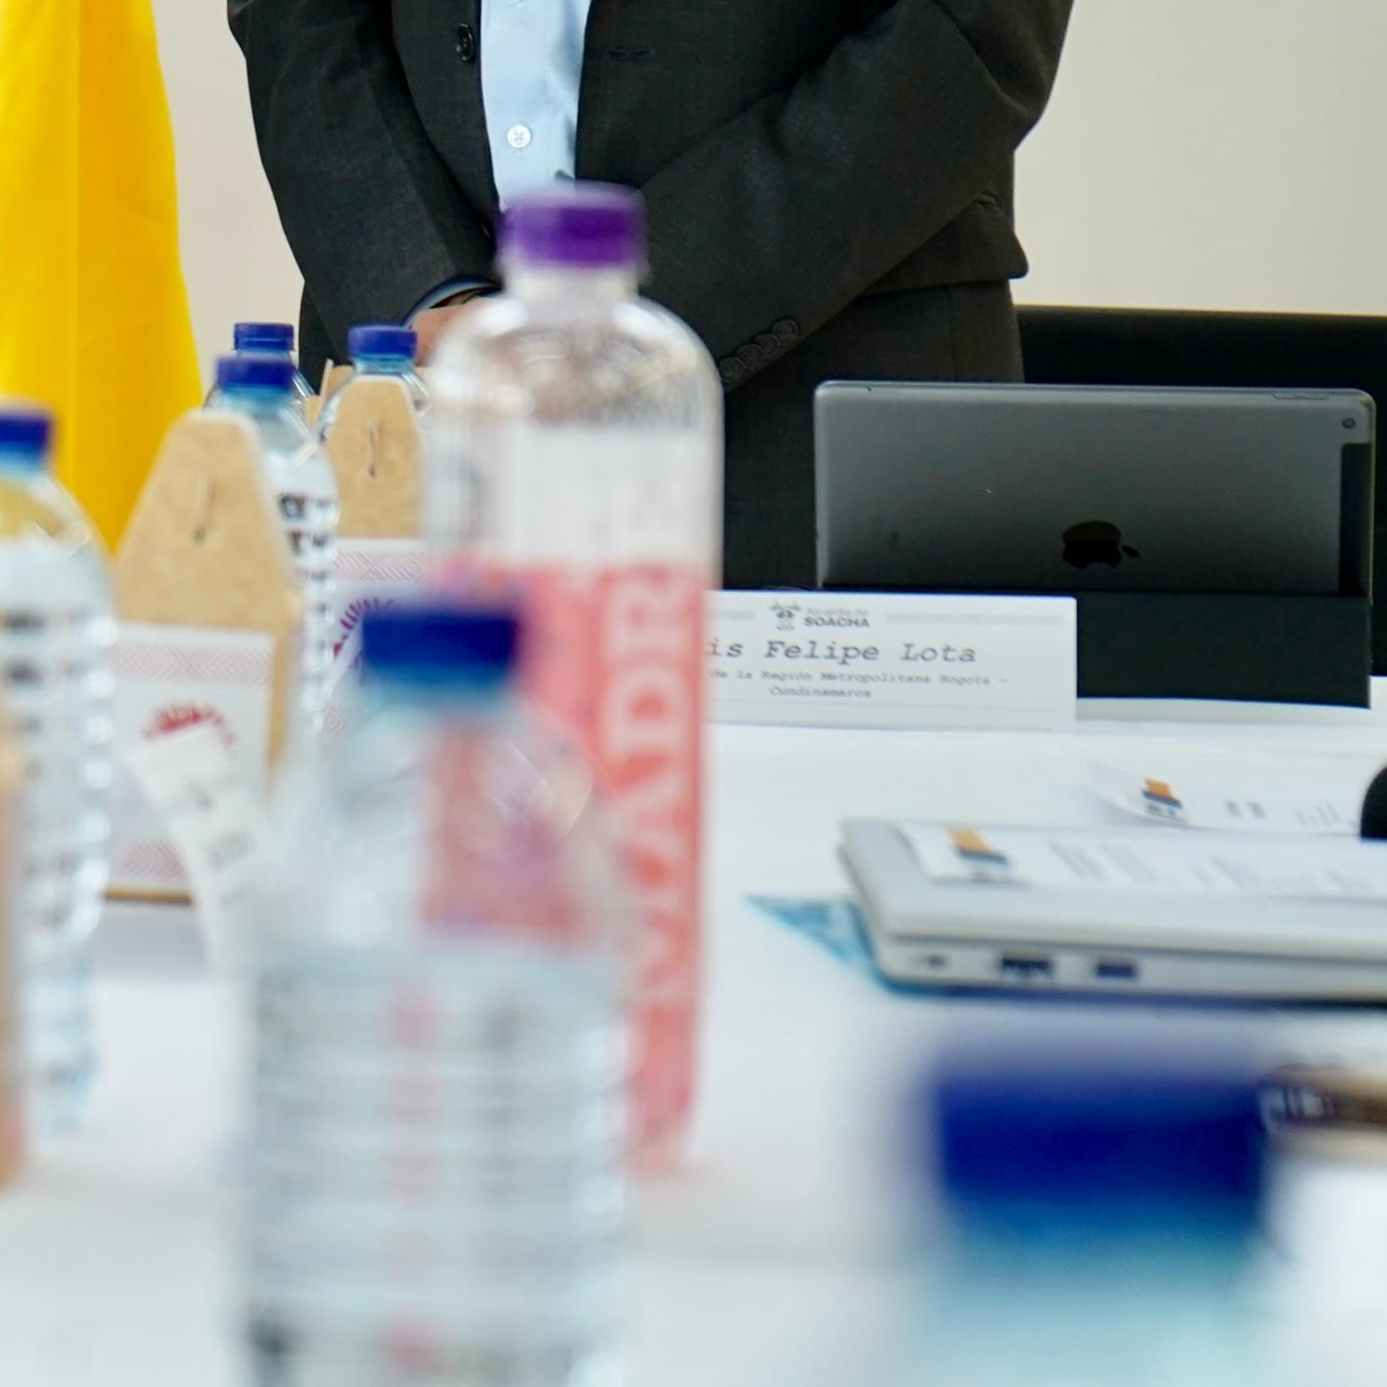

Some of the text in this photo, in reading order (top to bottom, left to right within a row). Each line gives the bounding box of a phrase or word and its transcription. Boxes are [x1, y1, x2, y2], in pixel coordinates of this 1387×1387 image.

[707, 637, 977, 665] is Felipe Lota
[819, 672, 931, 685] Metropolitana
